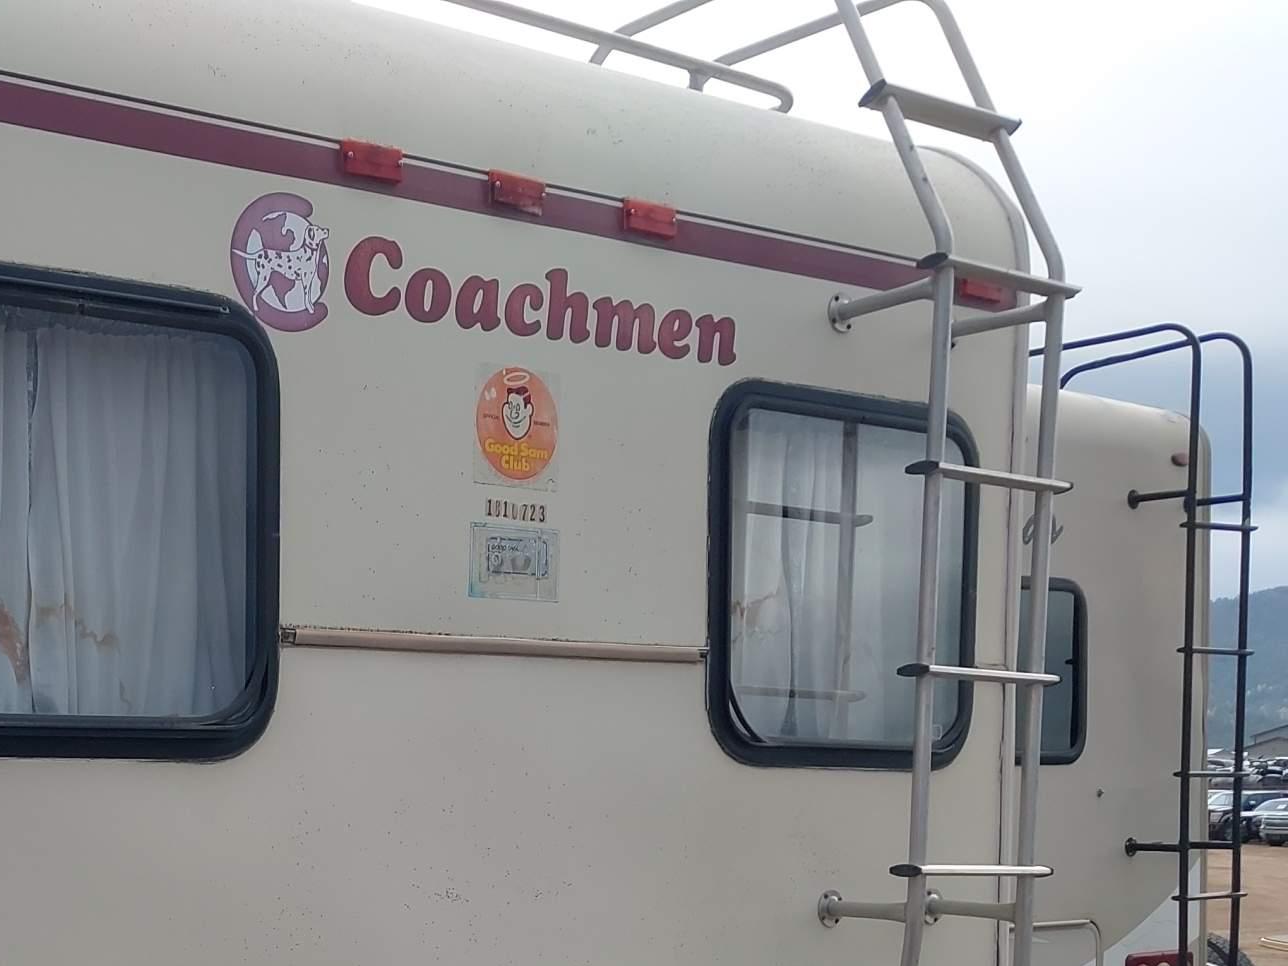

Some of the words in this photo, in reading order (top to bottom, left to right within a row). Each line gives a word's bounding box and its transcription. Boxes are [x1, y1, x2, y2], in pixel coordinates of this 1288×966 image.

[343, 235, 738, 366] Coachmen
[485, 438, 518, 456] Good
[520, 442, 548, 460] Sam
[501, 455, 531, 472] Club
